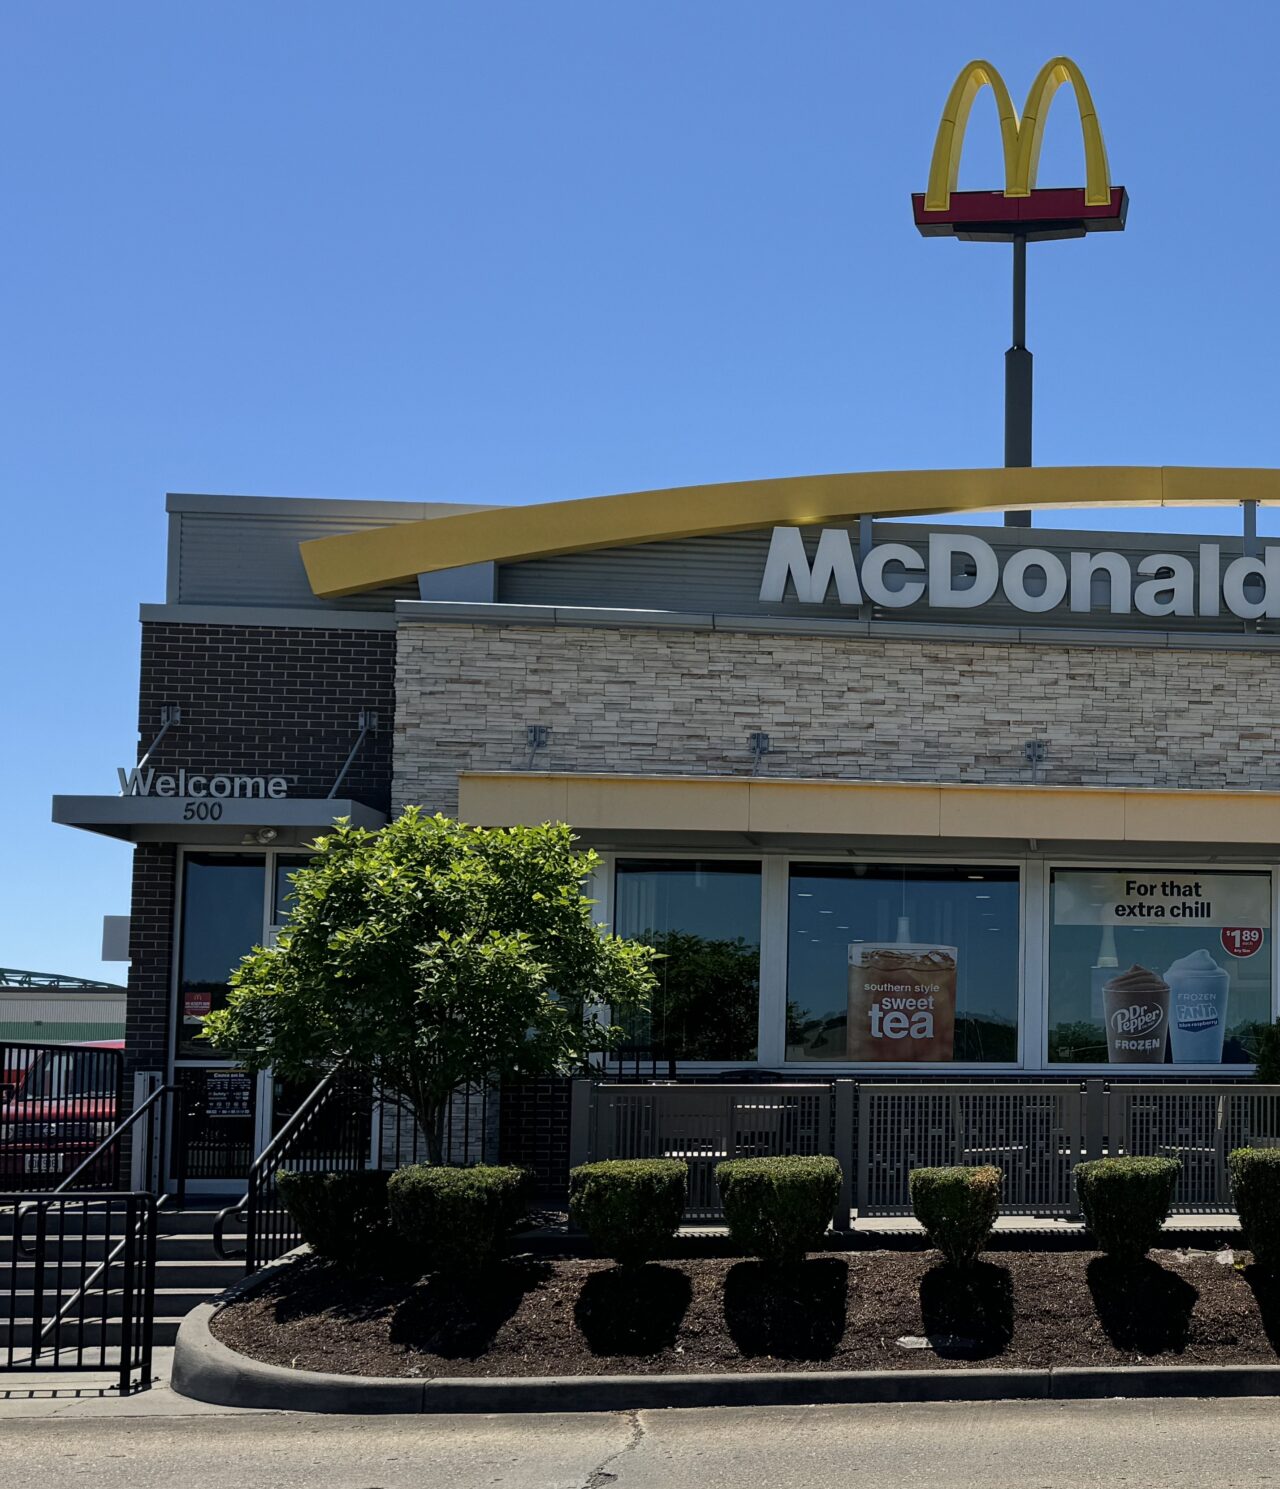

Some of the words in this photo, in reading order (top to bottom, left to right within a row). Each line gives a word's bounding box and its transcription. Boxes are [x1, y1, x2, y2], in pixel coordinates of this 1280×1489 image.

[117, 767, 288, 799] Welcome
[183, 801, 223, 821] 500
[1126, 880, 1156, 897] For
[1161, 880, 1202, 897] that
[1115, 902, 1165, 919] extra
[1169, 901, 1211, 919] chill
[864, 983, 911, 992] southern
[914, 983, 940, 994] style
[1177, 993, 1217, 1001] FROZEN
[881, 995, 935, 1010] sweet
[1129, 1005, 1148, 1020] Dr
[1176, 1003, 1217, 1021] FANTA
[868, 1003, 935, 1039] tea
[1115, 1009, 1160, 1033] Pepper
[1115, 1038, 1160, 1050] FROZEN
